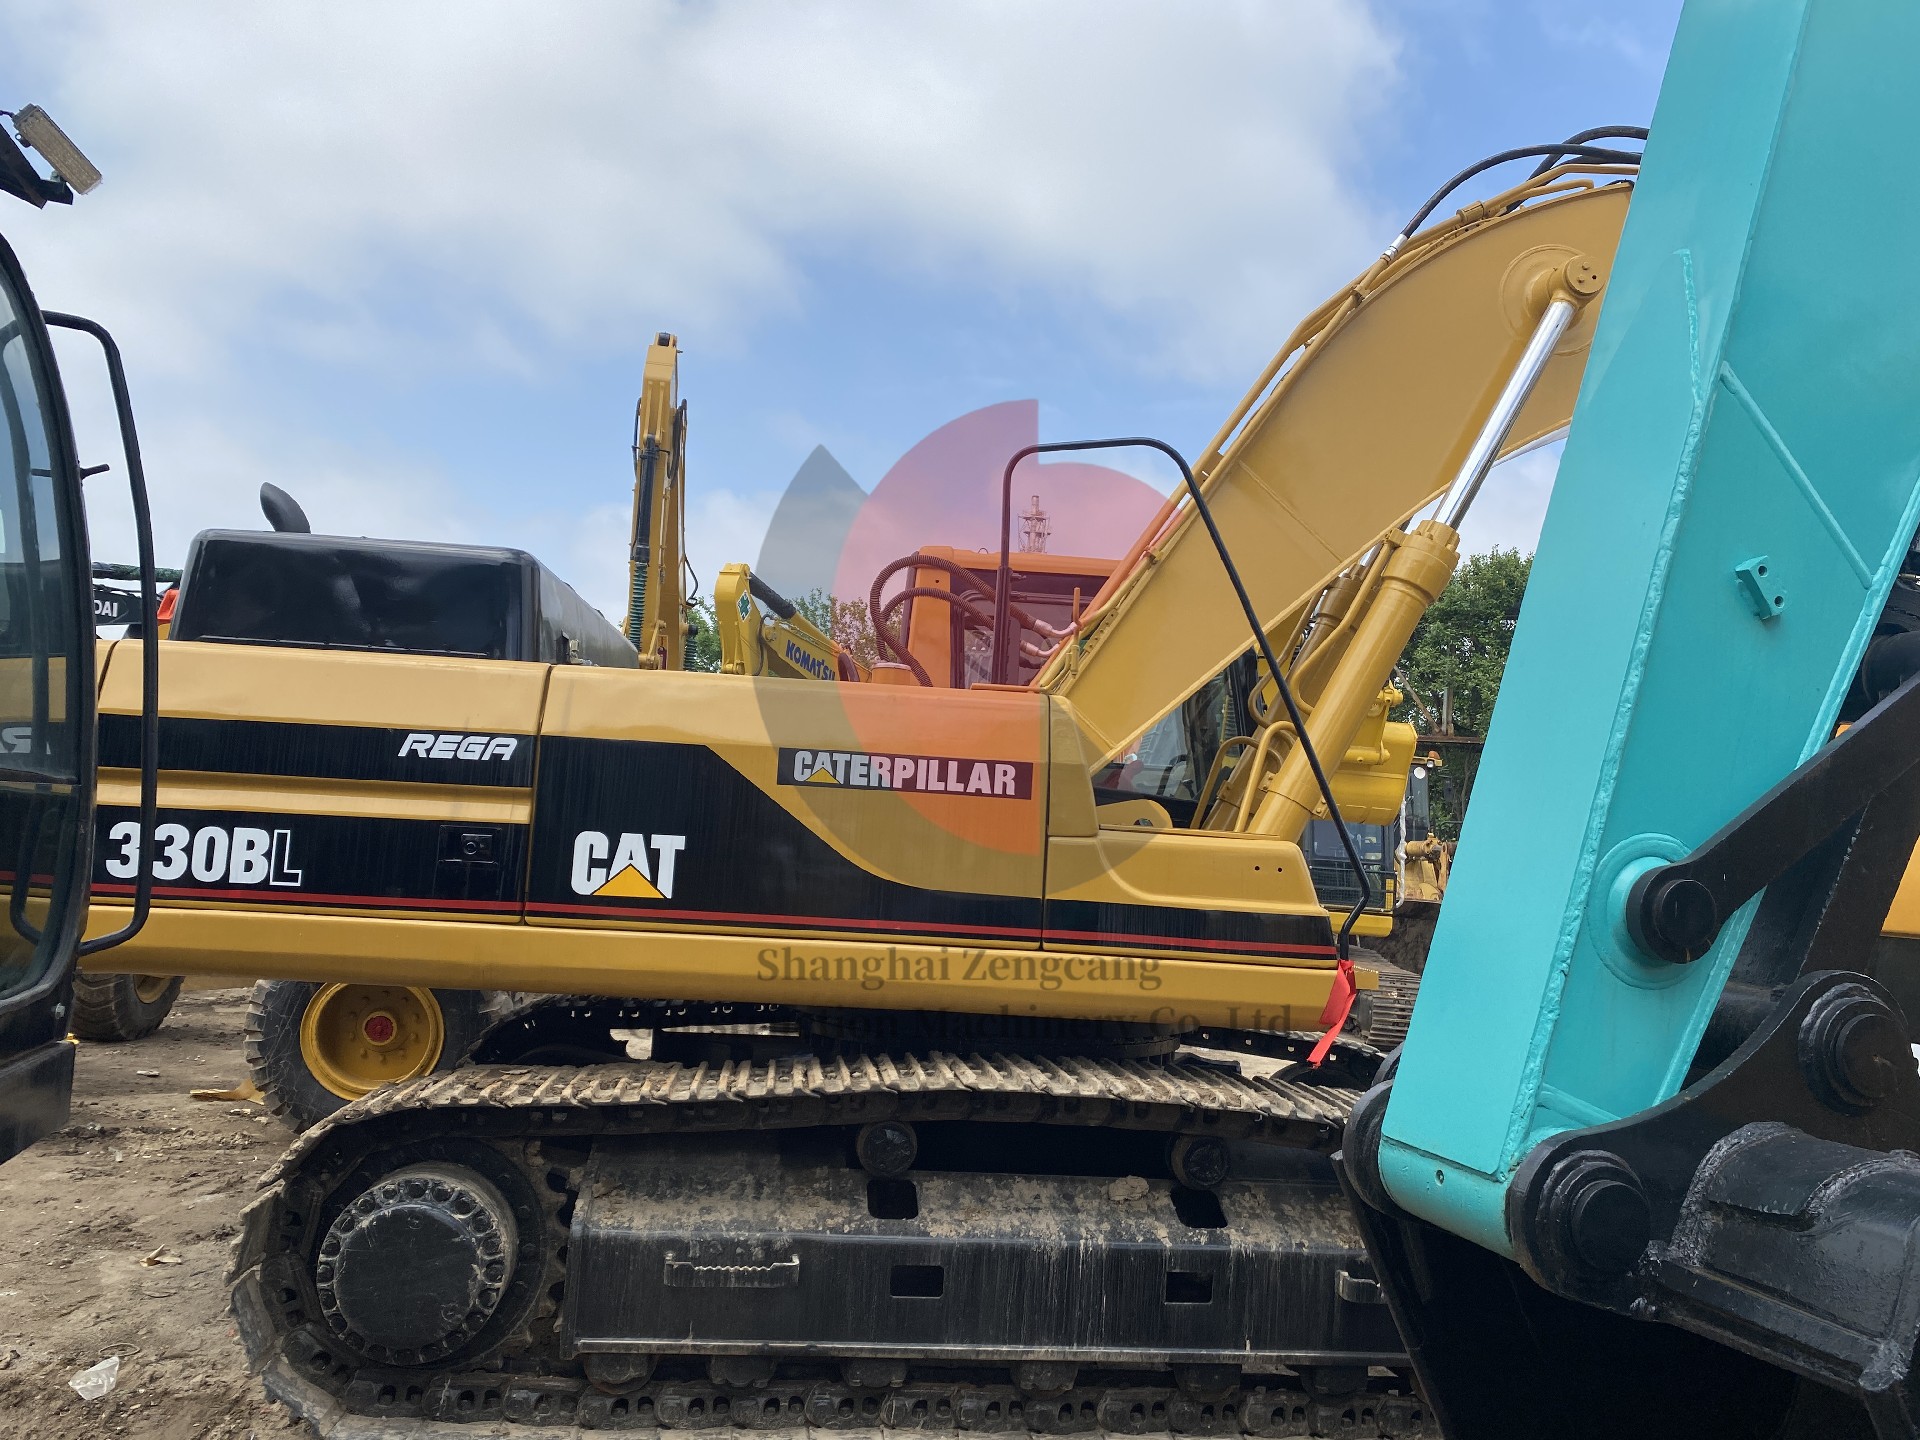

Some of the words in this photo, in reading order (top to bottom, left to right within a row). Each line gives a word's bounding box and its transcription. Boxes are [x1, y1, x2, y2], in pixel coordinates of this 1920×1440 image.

[398, 732, 518, 762] REGA
[793, 750, 1016, 797] CATERPILLAR
[105, 821, 303, 888] 330BL
[570, 830, 686, 899] CAT
